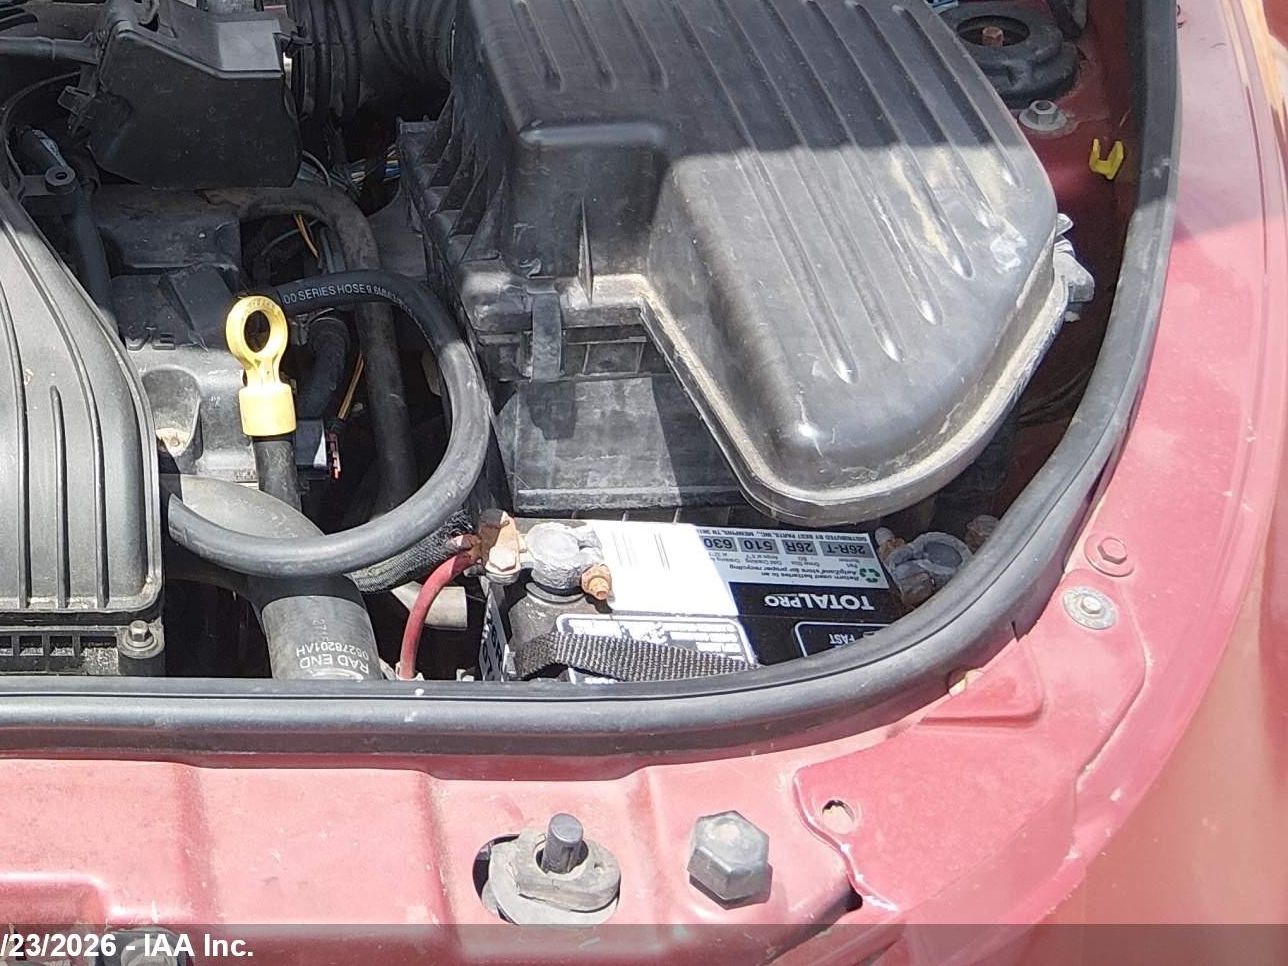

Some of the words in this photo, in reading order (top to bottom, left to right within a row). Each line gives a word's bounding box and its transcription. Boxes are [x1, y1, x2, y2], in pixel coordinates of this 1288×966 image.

[299, 285, 337, 302] SERIES
[338, 283, 366, 294] HOSE
[703, 537, 732, 549] 630
[742, 539, 774, 551] 510
[785, 541, 814, 553] 26R
[826, 543, 866, 555] 26R-T
[729, 564, 763, 572] recycling
[763, 592, 876, 611] TOTALPRO
[827, 633, 856, 645] FAST
[298, 654, 334, 669] END
[337, 654, 370, 675] RAD
